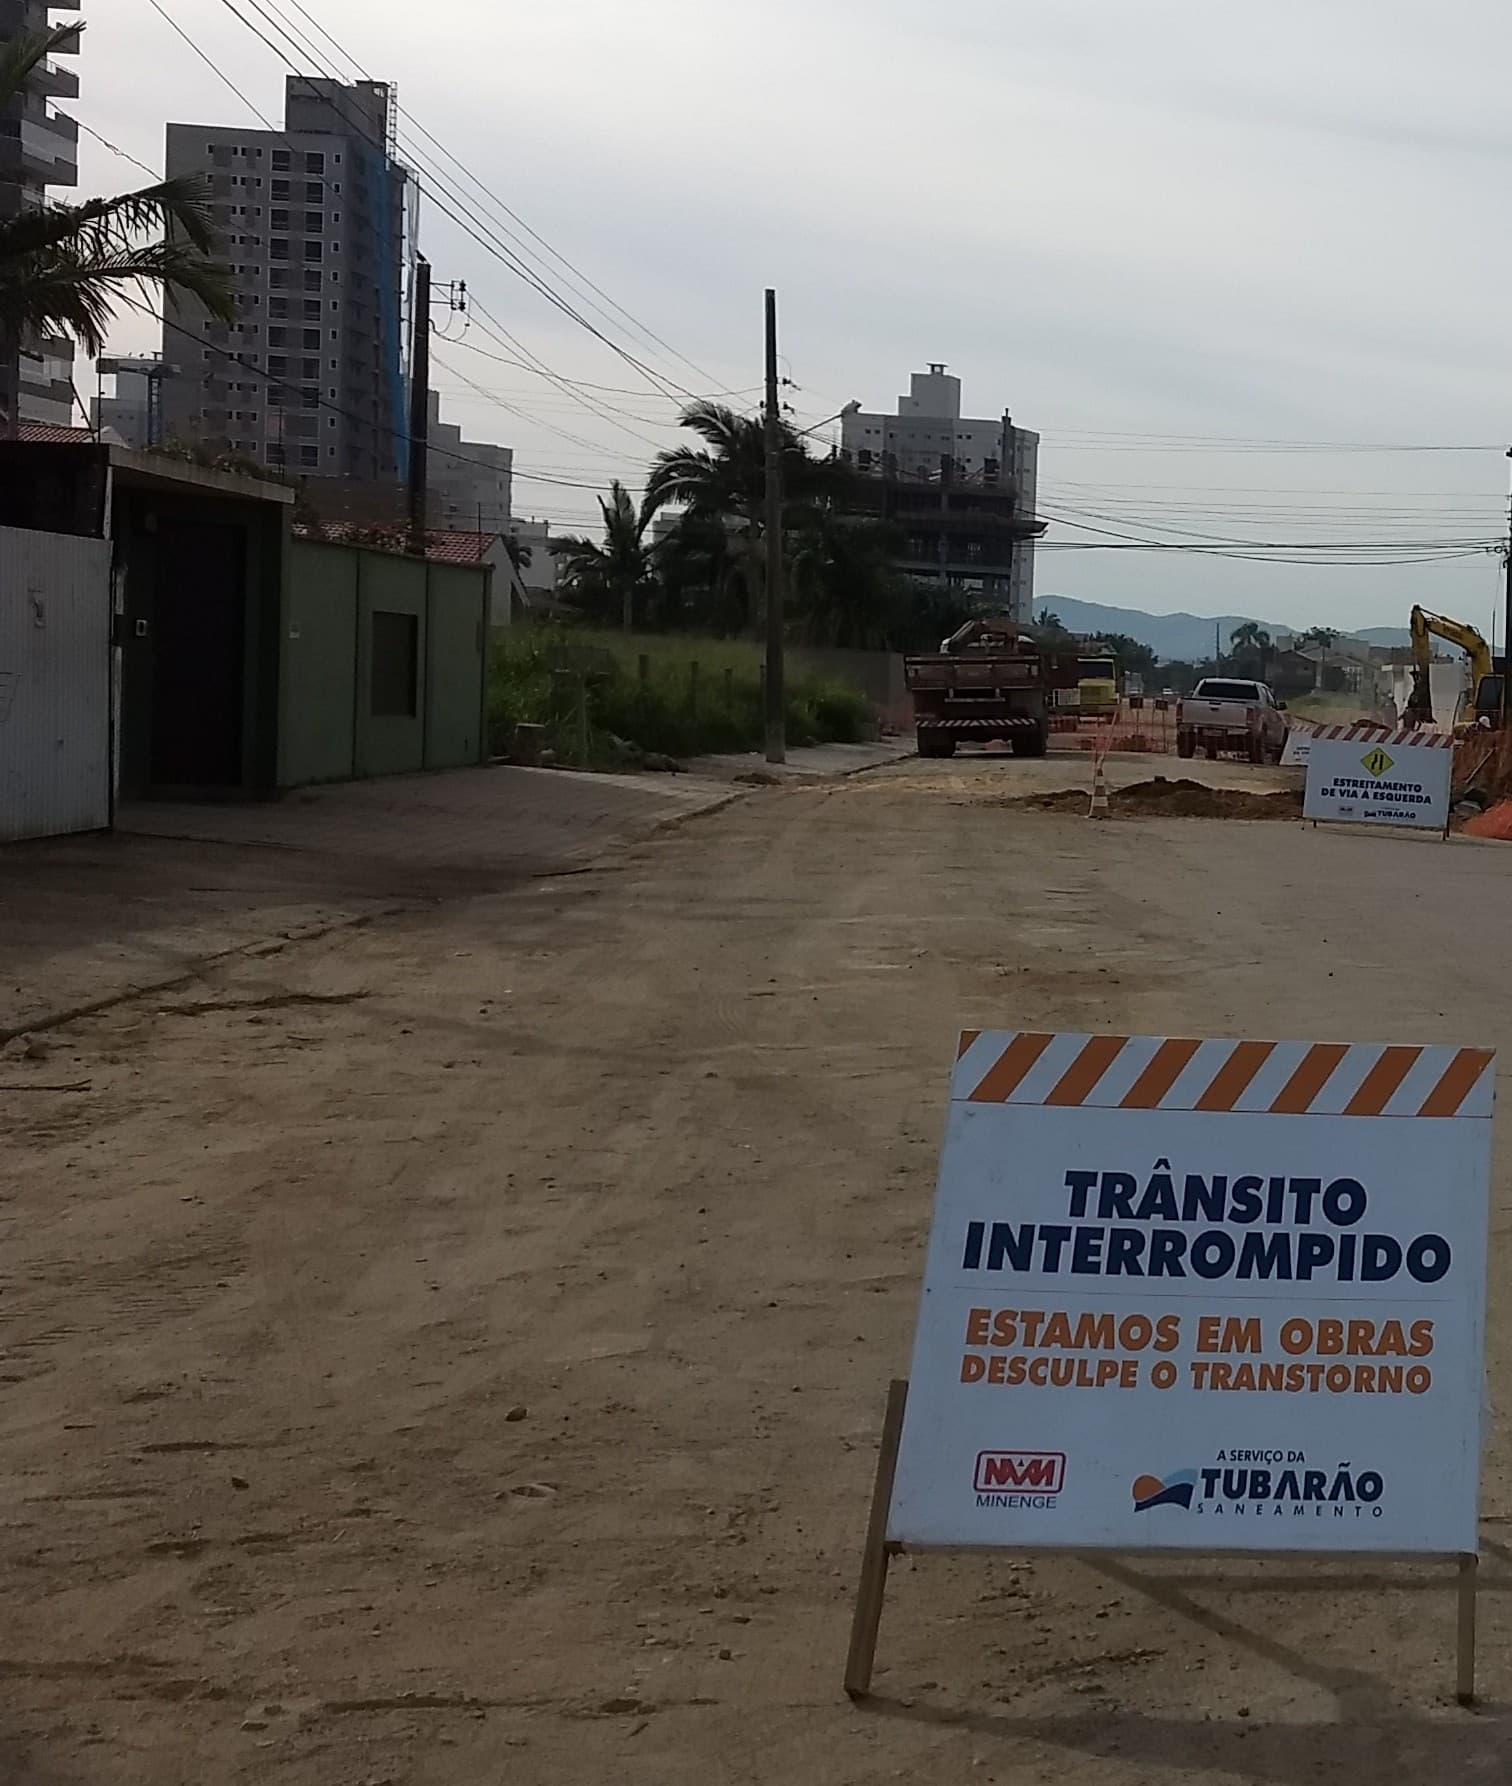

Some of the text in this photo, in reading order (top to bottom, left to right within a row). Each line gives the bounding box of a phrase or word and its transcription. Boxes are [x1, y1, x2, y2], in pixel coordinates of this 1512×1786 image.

[1321, 787, 1335, 797] DE
[1339, 789, 1358, 799] VIA
[1373, 791, 1432, 804] ESQUERDA
[1333, 778, 1422, 793] ESTREITAMENTO
[1064, 1158, 1368, 1227] TRÂNSITO
[962, 1222, 1452, 1283] INTERROMPIDO
[965, 1308, 1434, 1357] ESTAMOS EM OBRAS
[960, 1354, 1432, 1394] DESCULPE O TRANSTORNO
[1216, 1450, 1305, 1465] A SERVIÇO DA
[1200, 1462, 1383, 1502] TUBARÃO
[976, 1494, 1057, 1509] MINENGE
[1197, 1503, 1382, 1517] SANEAMENTO
